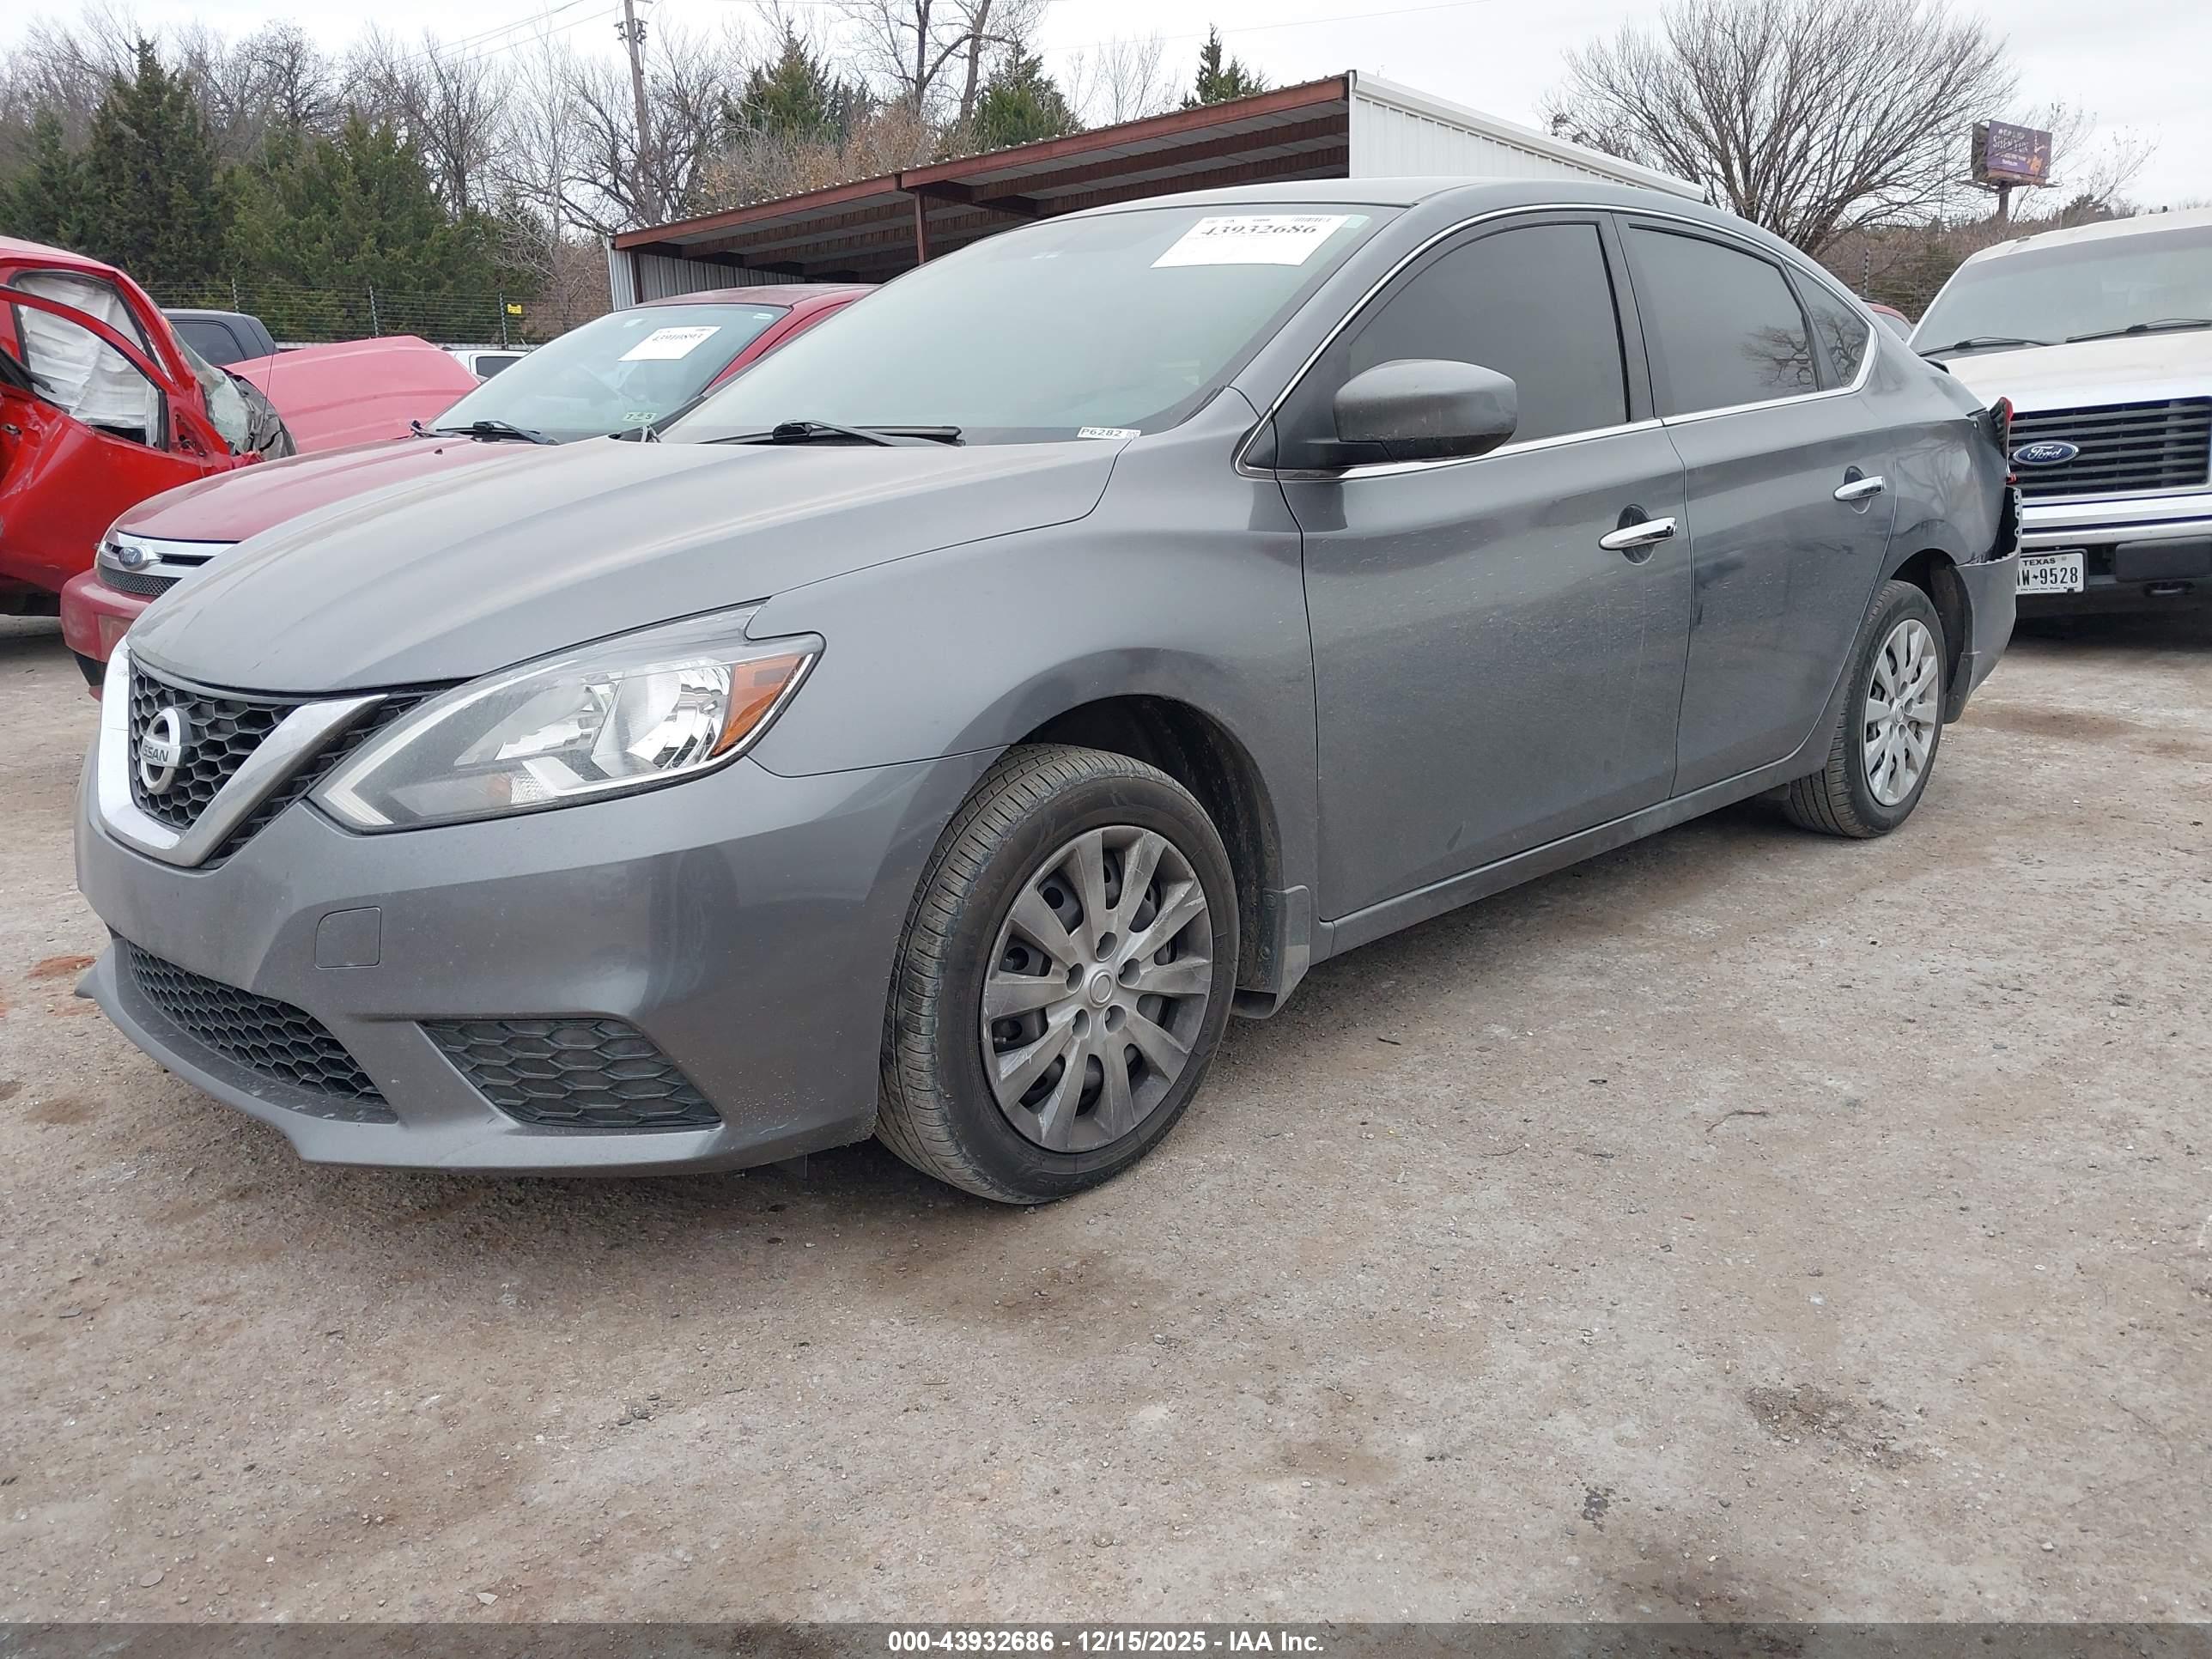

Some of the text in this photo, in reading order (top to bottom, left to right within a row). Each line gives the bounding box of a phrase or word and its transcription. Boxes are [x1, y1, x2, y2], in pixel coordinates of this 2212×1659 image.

[1200, 225, 1318, 236] 43932686
[1081, 428, 1122, 437] P6282
[2027, 446, 2063, 461] Ford
[2021, 557, 2057, 567] TEXAS
